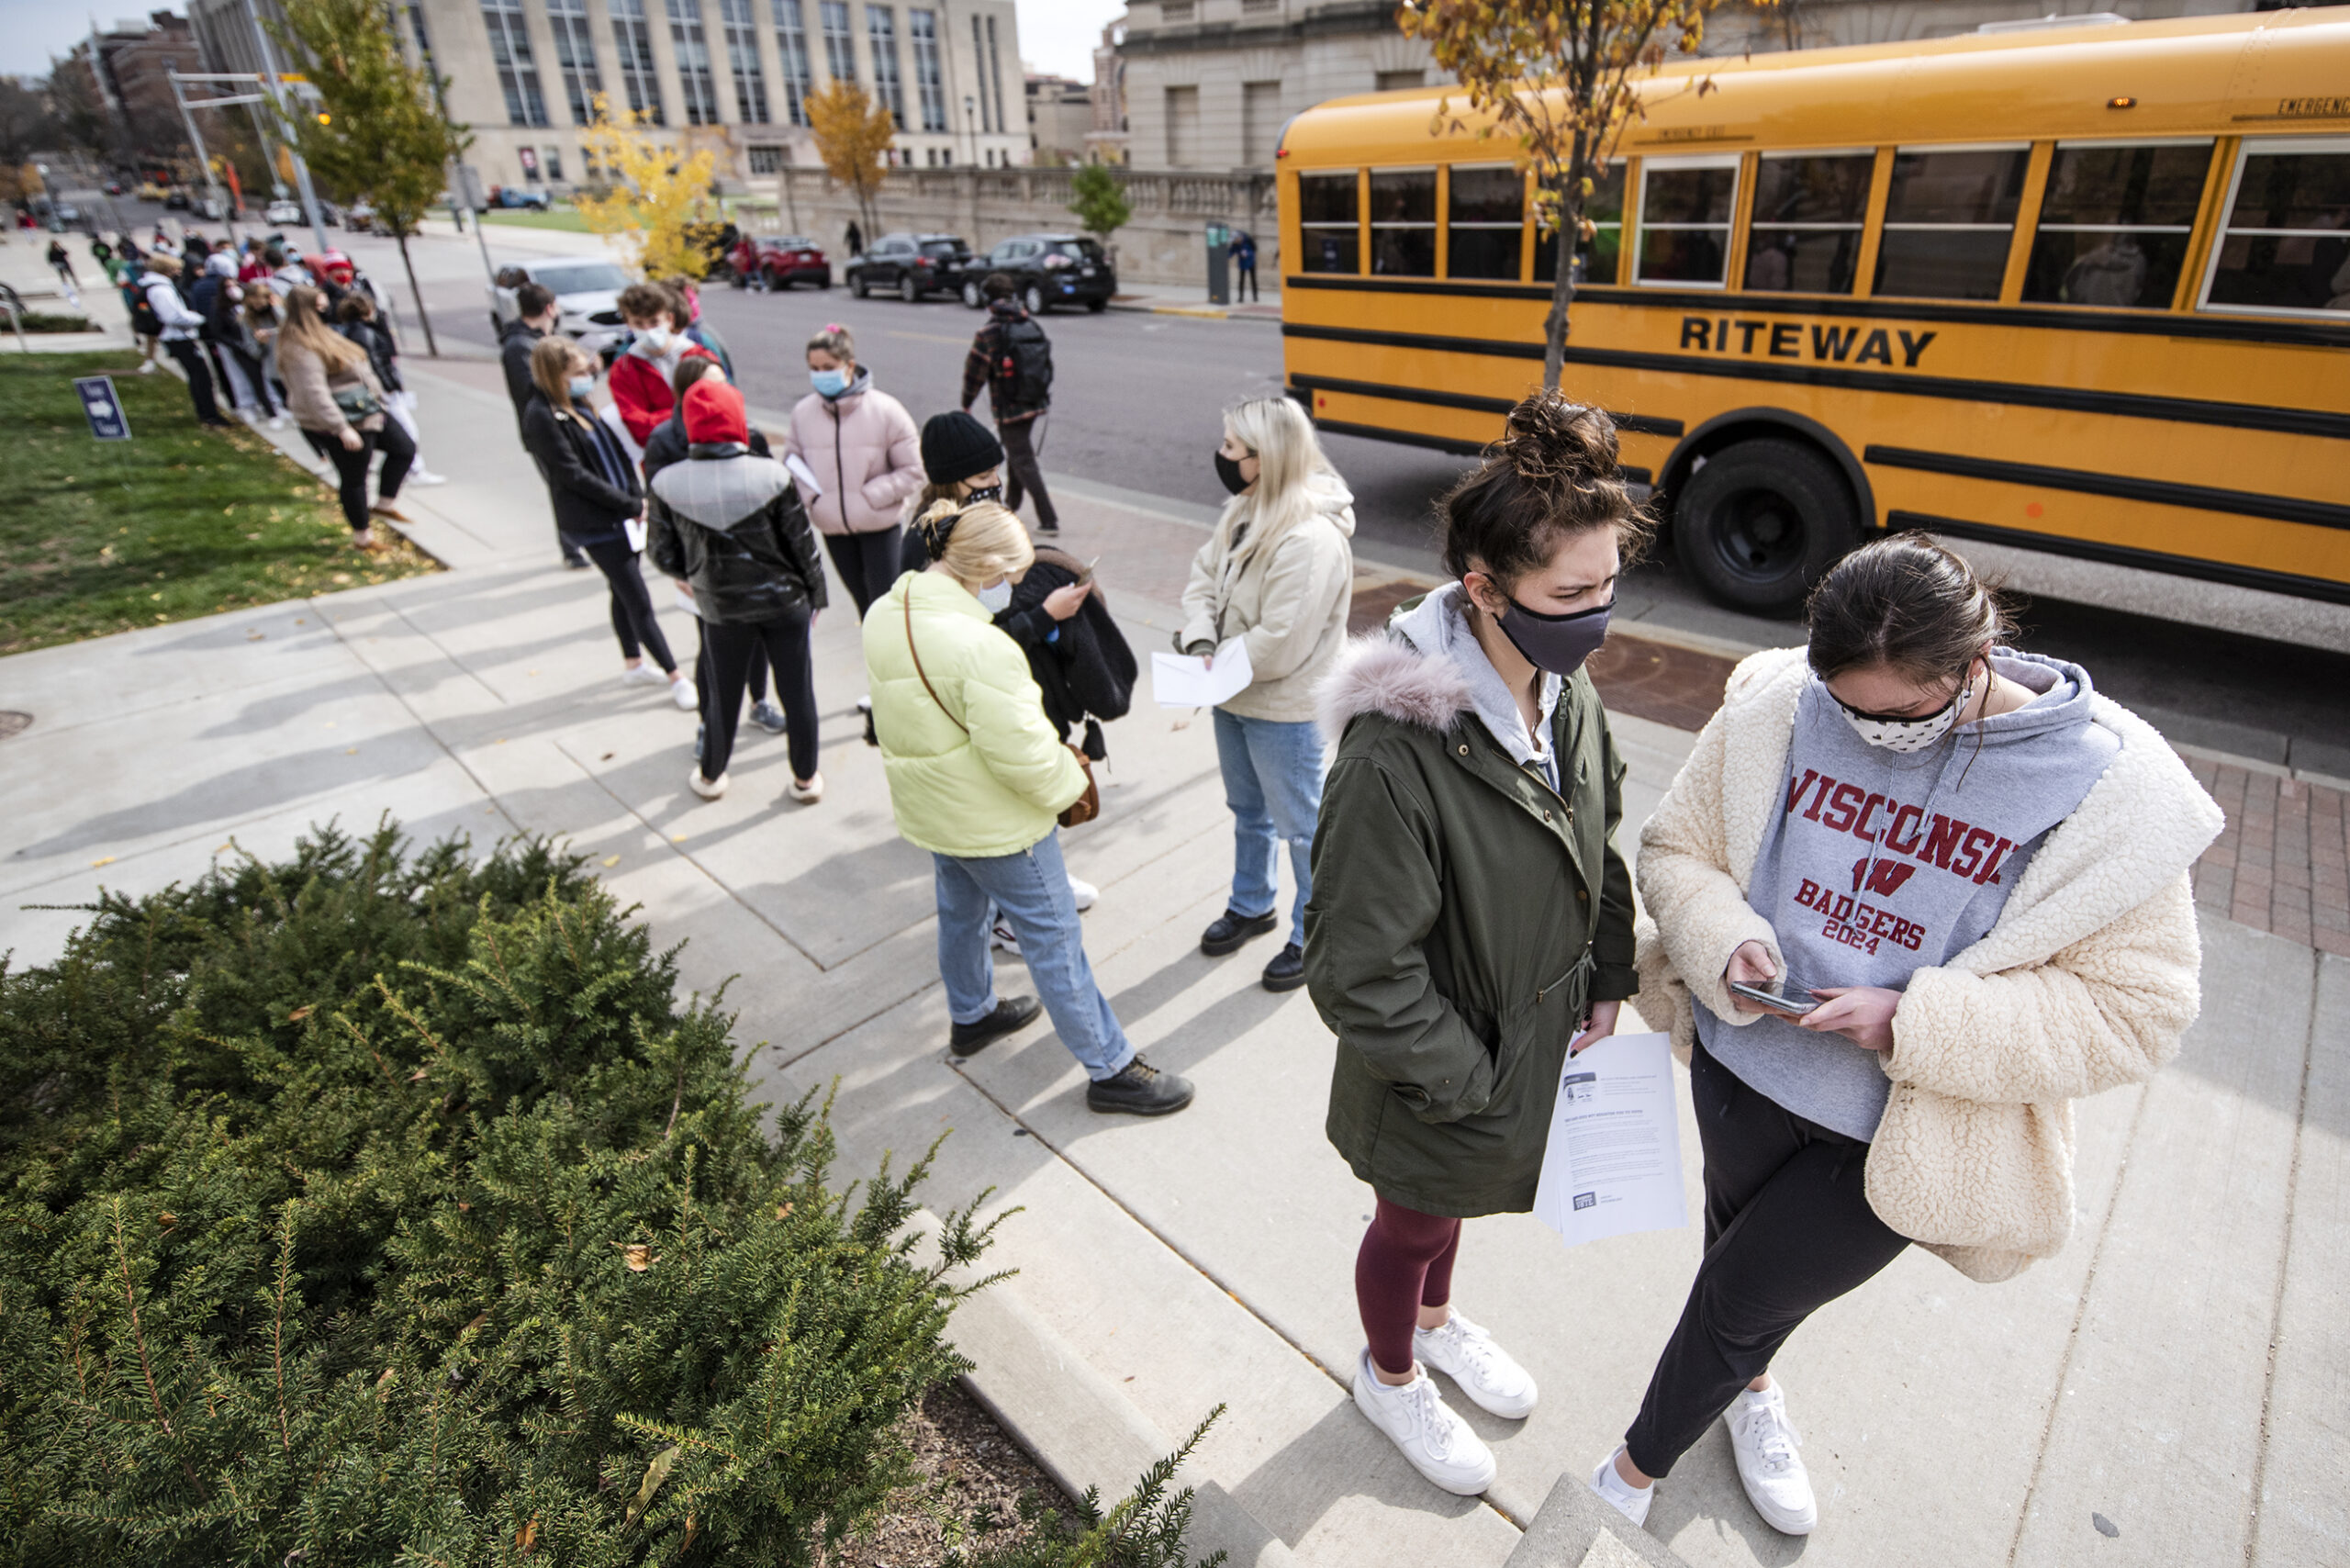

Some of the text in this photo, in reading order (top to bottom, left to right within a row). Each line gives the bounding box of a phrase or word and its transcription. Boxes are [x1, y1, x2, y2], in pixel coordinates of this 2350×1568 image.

[1680, 316, 1938, 367] RITEWAY
[1787, 767, 2020, 885] ISCONSI
[1794, 878, 1926, 951] BADGERS
[1821, 919, 1881, 956] 2024
